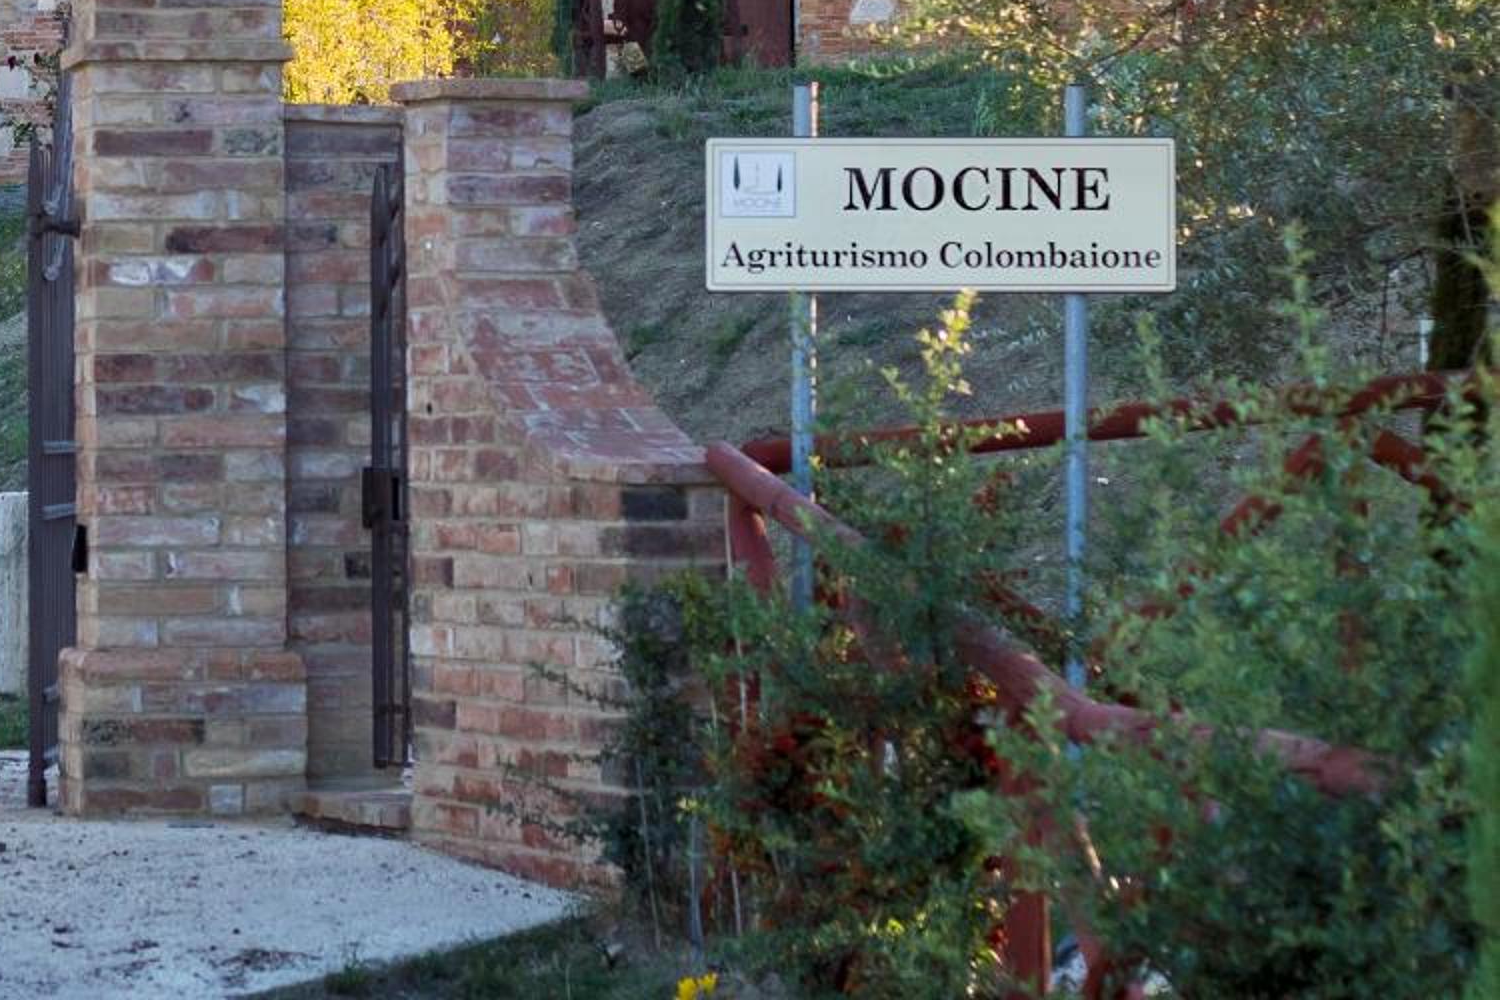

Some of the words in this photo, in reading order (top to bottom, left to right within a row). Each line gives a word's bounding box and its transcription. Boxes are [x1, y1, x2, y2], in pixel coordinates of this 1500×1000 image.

[843, 166, 1111, 212] MOCINE
[721, 241, 928, 273] Agriturismo
[939, 241, 1162, 269] Colombaione
